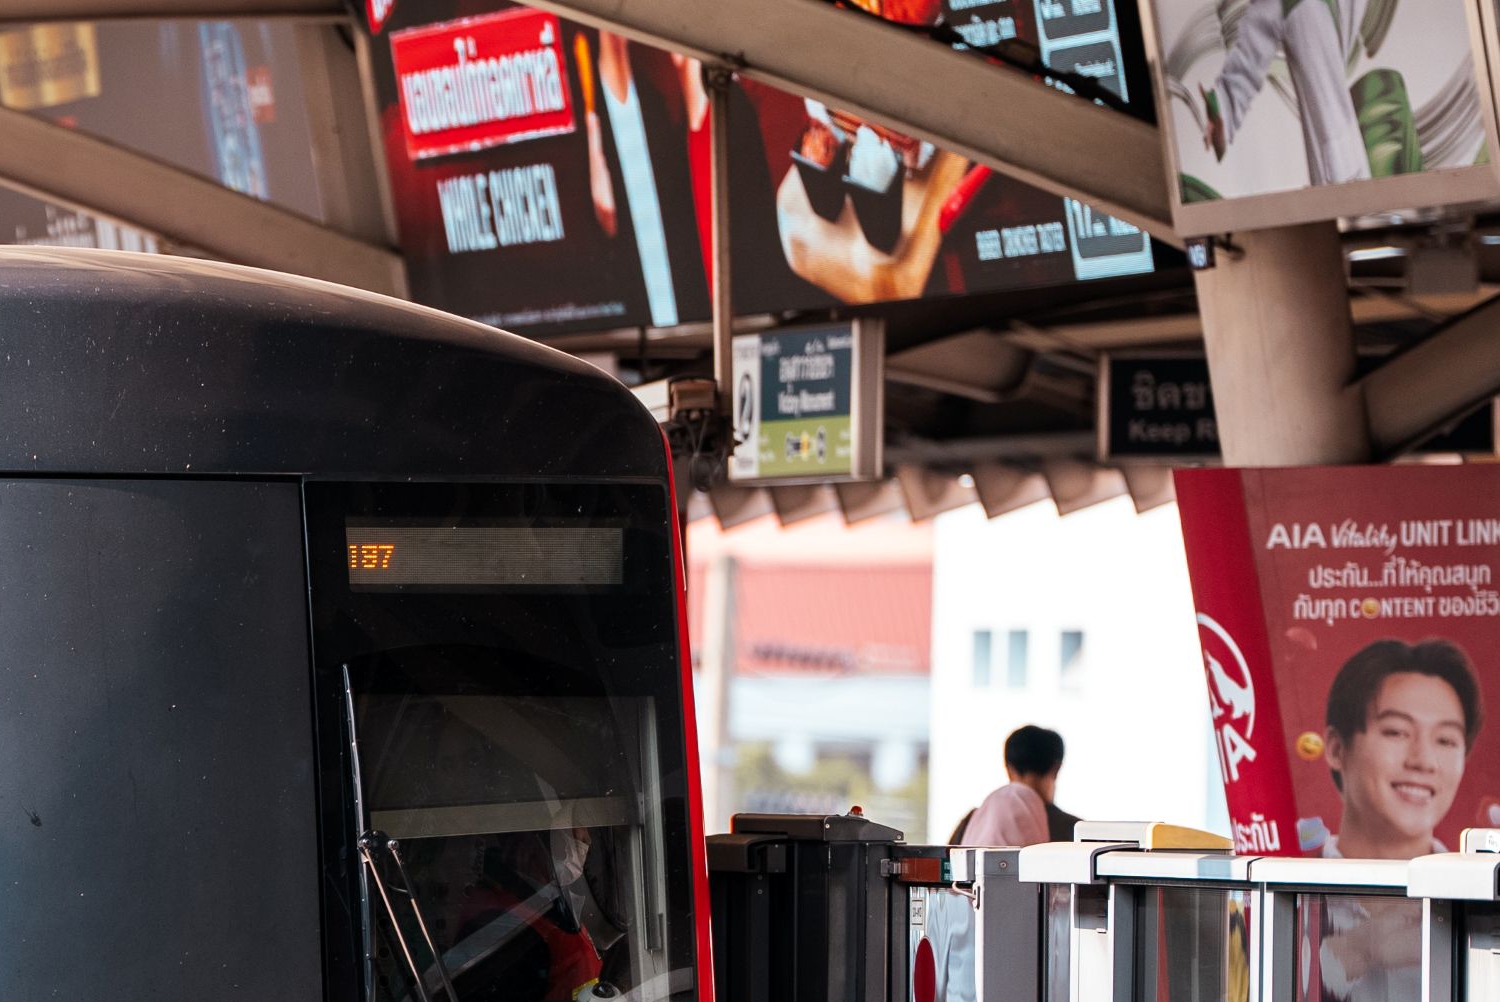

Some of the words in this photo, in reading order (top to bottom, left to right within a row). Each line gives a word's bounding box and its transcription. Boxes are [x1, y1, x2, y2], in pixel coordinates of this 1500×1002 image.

[1266, 523, 1327, 550] AIA
[1331, 518, 1398, 556] Vitality
[1401, 519, 1453, 548] UNIT
[1293, 593, 1348, 627] กับทุก
[1438, 590, 1500, 617] ของชีวิ
